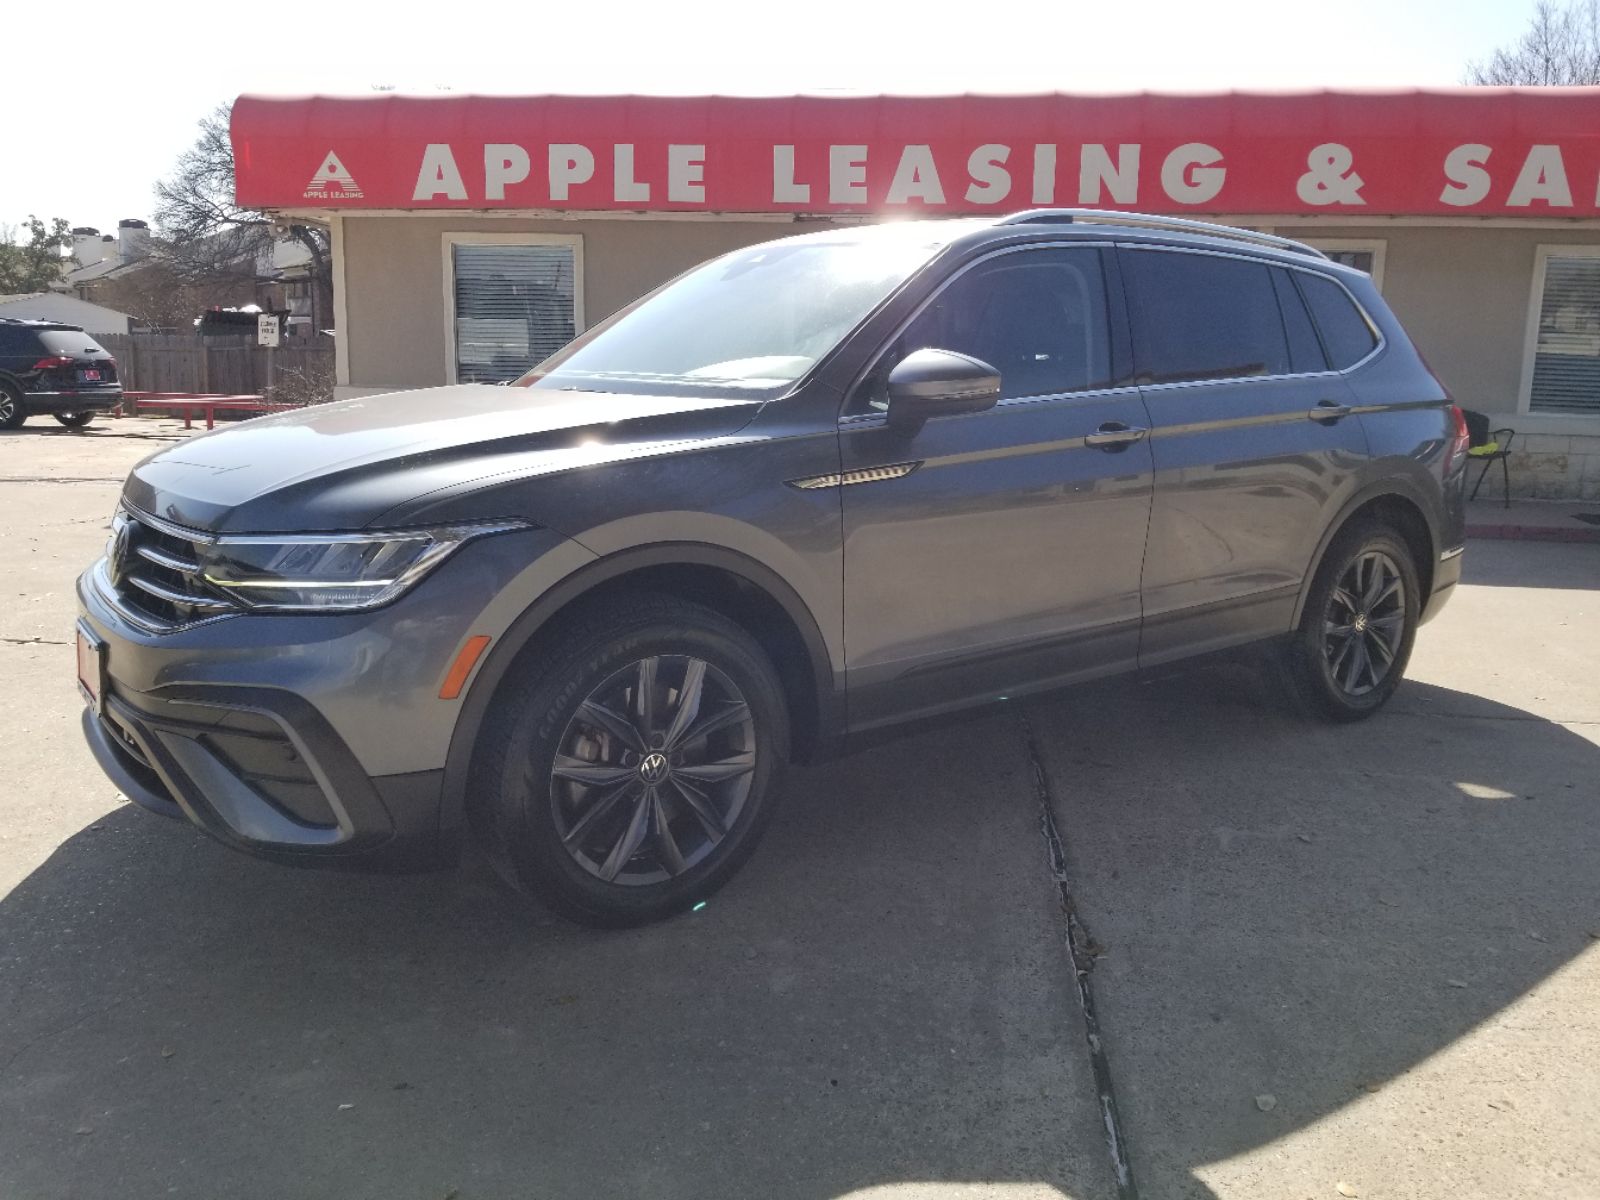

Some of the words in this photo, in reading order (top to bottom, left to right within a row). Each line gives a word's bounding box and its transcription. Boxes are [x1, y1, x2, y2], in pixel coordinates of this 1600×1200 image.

[413, 143, 706, 202] APPLE
[773, 143, 1226, 204] LEASING
[1296, 143, 1367, 206] &
[1439, 143, 1600, 207] SA
[303, 191, 328, 199] APPLE
[330, 191, 365, 199] LEASING
